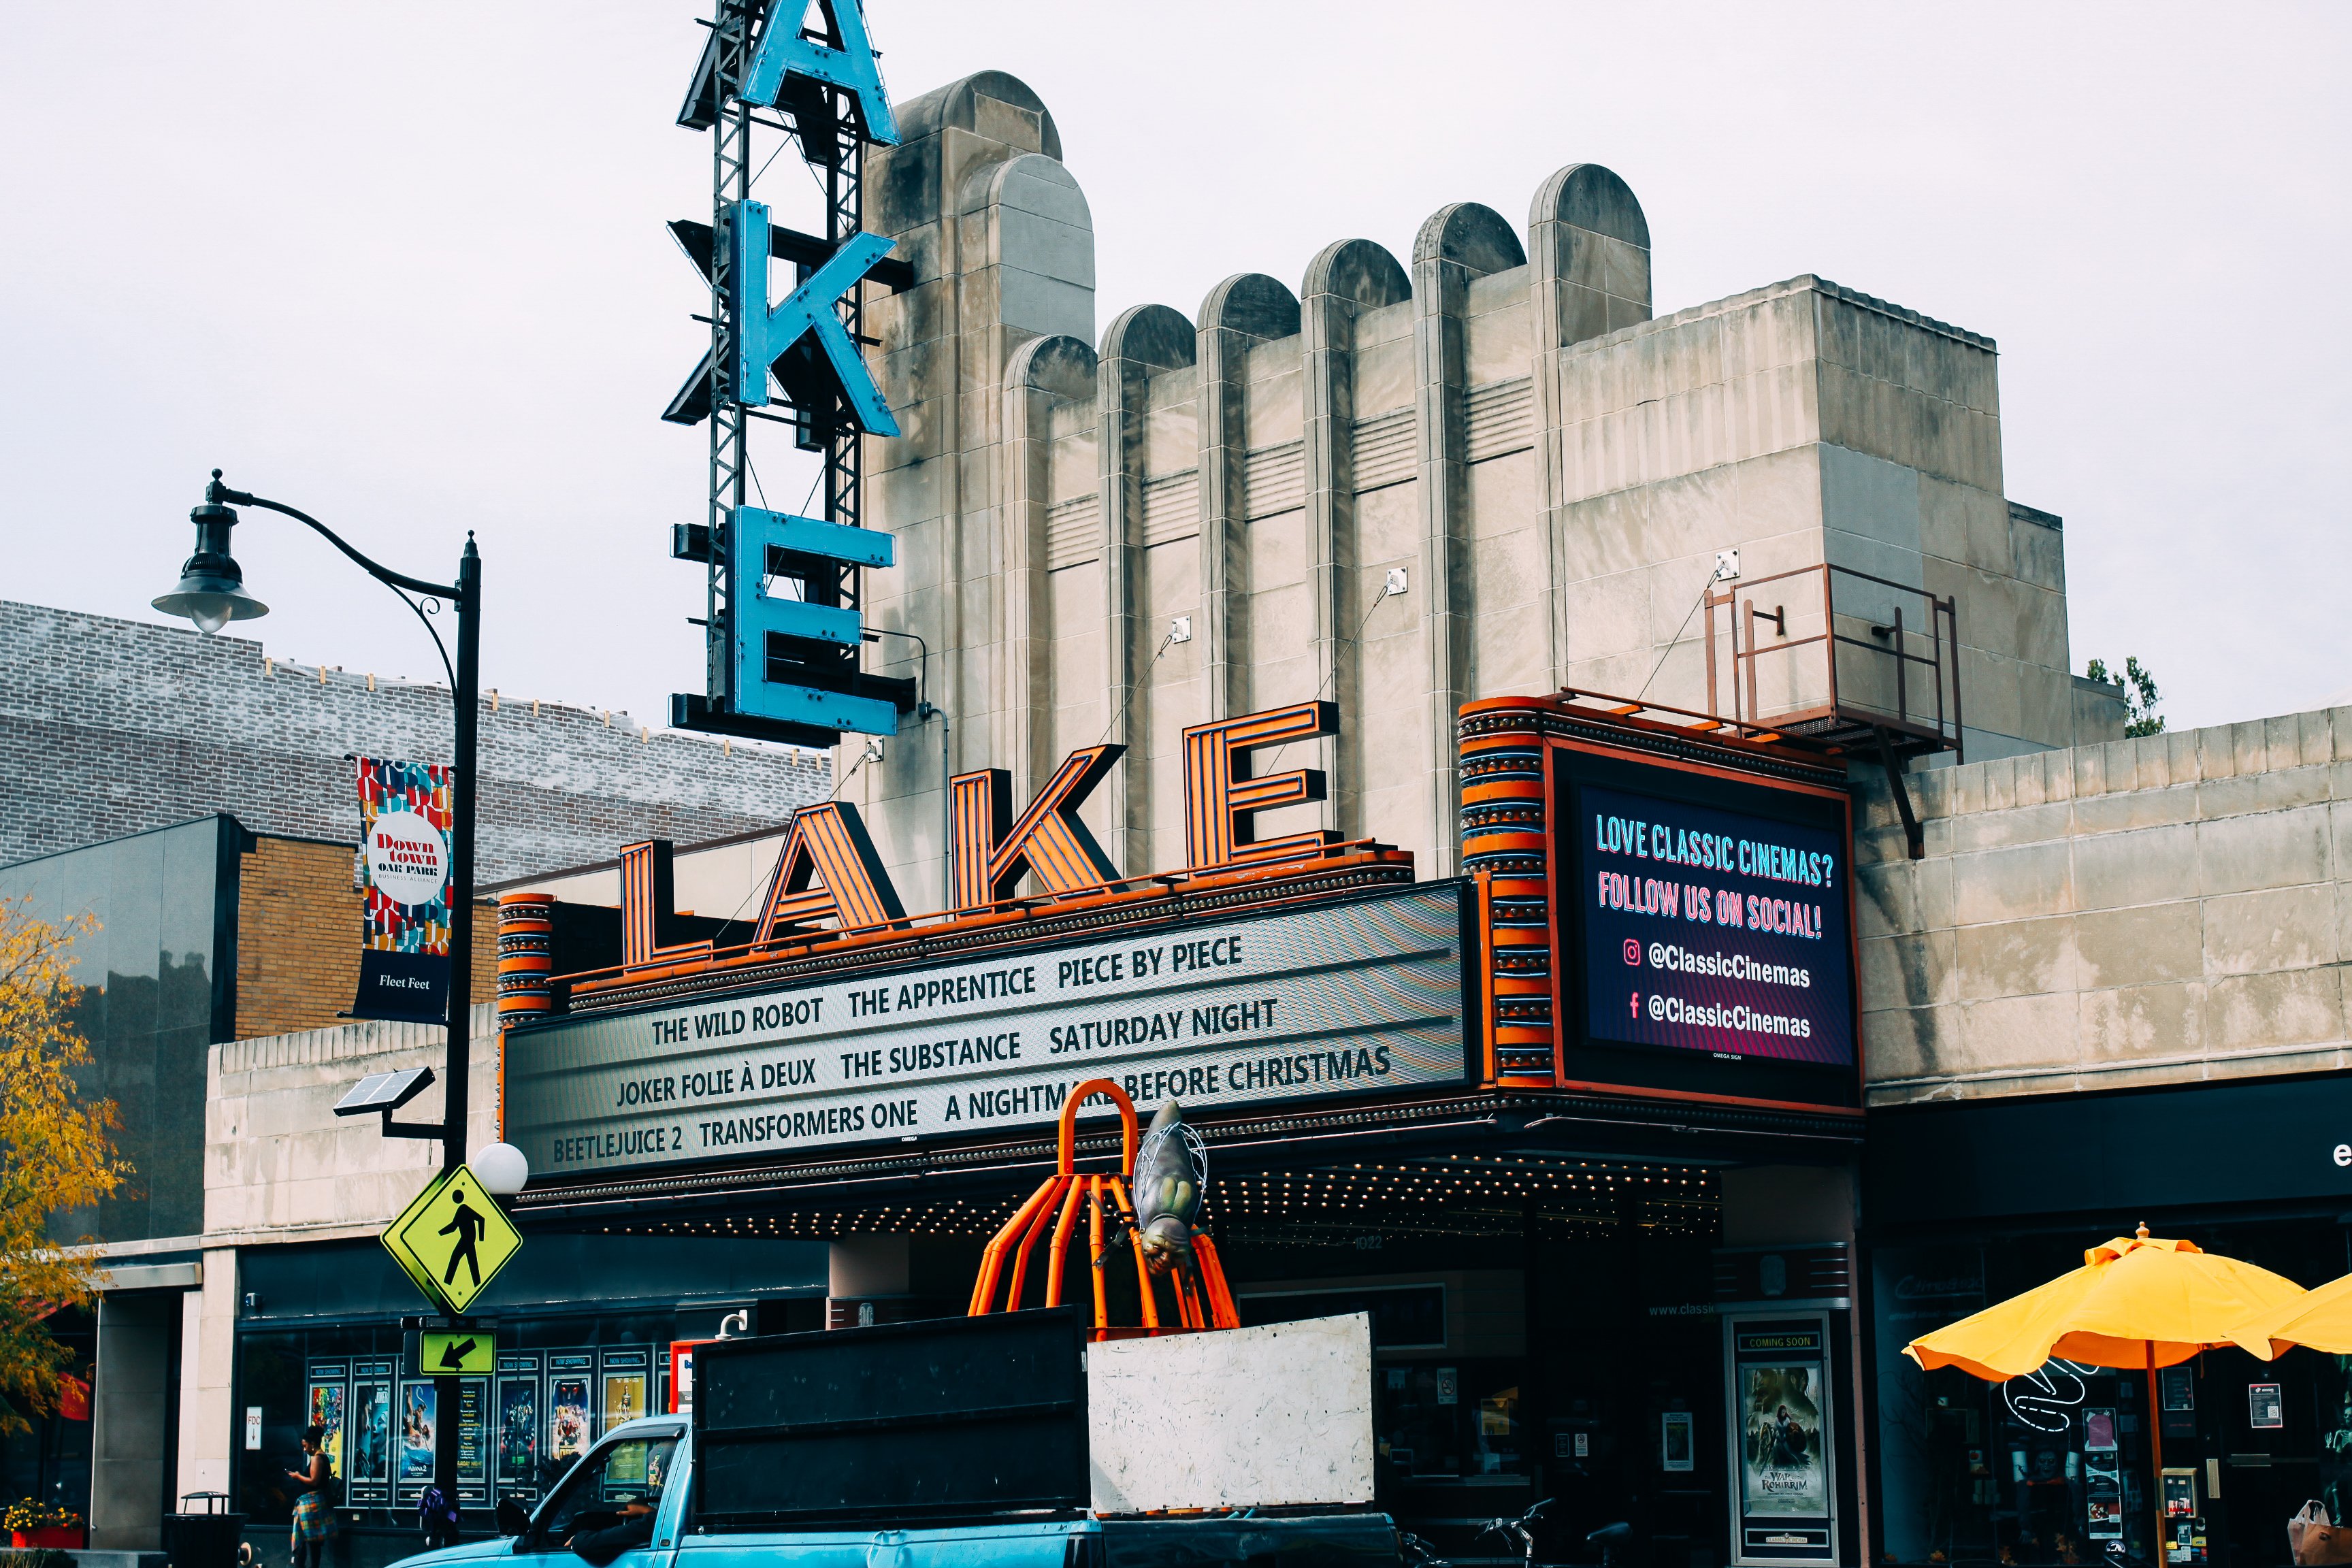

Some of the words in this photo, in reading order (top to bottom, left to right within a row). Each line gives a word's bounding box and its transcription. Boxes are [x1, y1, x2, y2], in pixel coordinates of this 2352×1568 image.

[376, 832, 434, 854] Down
[389, 848, 438, 866] town
[619, 700, 1338, 977] LAKE
[1596, 814, 1648, 858] LOVE
[1652, 823, 1735, 872] CLASSIC
[1738, 839, 1834, 888] CINEMAS?
[378, 862, 403, 874] OAK
[406, 865, 438, 877] PARK
[378, 873, 407, 881] BUSINESS
[1598, 870, 1680, 917] FOLLOW
[1684, 885, 1712, 924] US
[1716, 889, 1744, 928] ON
[1746, 895, 1823, 939] SOCIAL!
[380, 974, 406, 988] Fleet
[408, 977, 430, 990] Feet
[1648, 942, 1810, 988] @ClassicCinemas
[652, 1019, 689, 1046] THE
[694, 1009, 746, 1039] WILD
[753, 997, 824, 1033] ROBOT
[848, 987, 890, 1017] THE
[897, 966, 1036, 1011] APPRENTICE
[1058, 952, 1124, 989] PIECE
[1132, 947, 1163, 978] BY
[1173, 935, 1243, 973] PIECE
[1648, 994, 1811, 1038] @ClassicCinemas
[617, 1076, 676, 1107] JOKER
[682, 1068, 735, 1100] FOLIE
[740, 1060, 755, 1092] À
[762, 1057, 817, 1090] DEUX
[840, 1049, 883, 1079] THE
[889, 1032, 1022, 1075] SUBSTANCE
[1049, 1010, 1184, 1054] SATURDAY
[1192, 998, 1278, 1036] NIGHT
[553, 1128, 667, 1164] BEETLEJUICE
[672, 1126, 683, 1151] 2
[700, 1104, 865, 1147] TRANSFORMERS
[871, 1098, 918, 1129] ONE
[945, 1094, 962, 1122] A
[1124, 1064, 1220, 1102] BEFORE
[1228, 1045, 1391, 1090] CHRISTMAS
[1750, 1338, 1784, 1348] COMING
[1786, 1337, 1811, 1347] SOON
[248, 1416, 261, 1425] FDC
